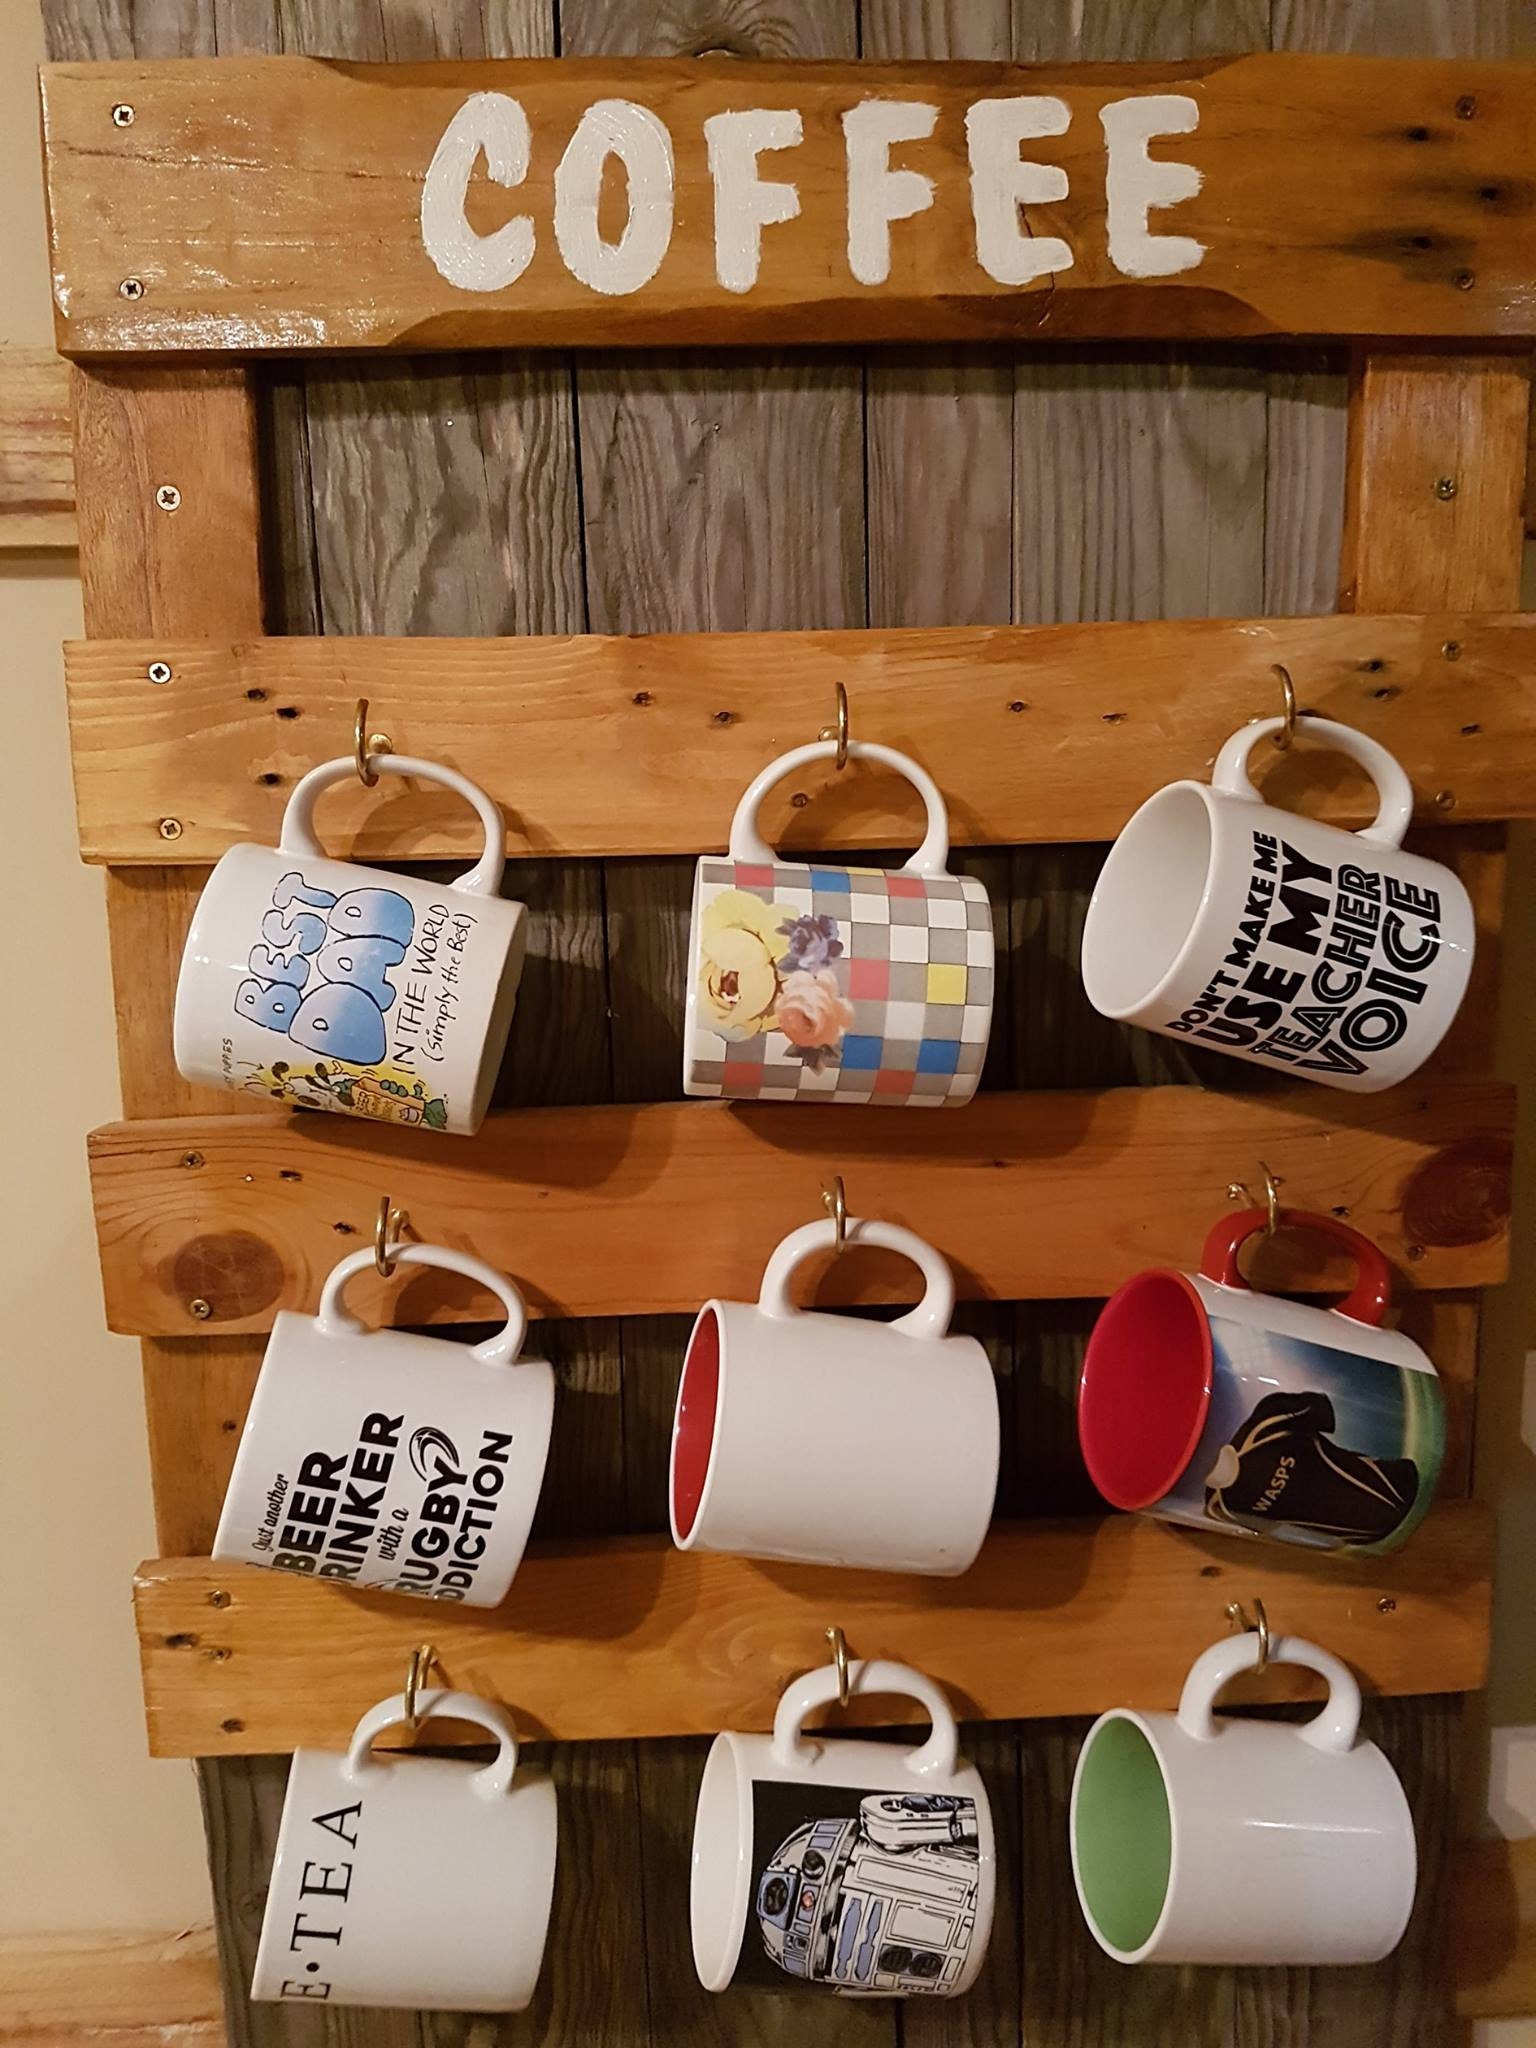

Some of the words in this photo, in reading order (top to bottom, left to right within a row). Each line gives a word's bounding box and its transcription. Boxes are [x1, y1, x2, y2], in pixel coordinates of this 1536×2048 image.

[421, 91, 1207, 294] COFFEE
[234, 871, 339, 1034] BEST
[287, 887, 416, 1066] DAD
[394, 981, 428, 1035] THE
[411, 903, 450, 976] WORLD
[1165, 969, 1240, 1033] DON'T
[1224, 876, 1276, 969] MAKE
[1252, 830, 1278, 874] ME
[1192, 961, 1307, 1046] USE
[1266, 839, 1333, 956] MY
[1247, 864, 1381, 1062] TEACHER
[1293, 875, 1441, 1075] VOICE
[392, 1041, 417, 1074] IN
[264, 1473, 291, 1531] another
[272, 1451, 349, 1574] BEER
[319, 1412, 405, 1583] RINKER
[377, 1523, 404, 1561] with
[391, 1507, 410, 1522] a
[394, 1455, 469, 1596] RUGBY
[432, 1430, 513, 1601] DDICTION
[1252, 1455, 1297, 1513] WASPS
